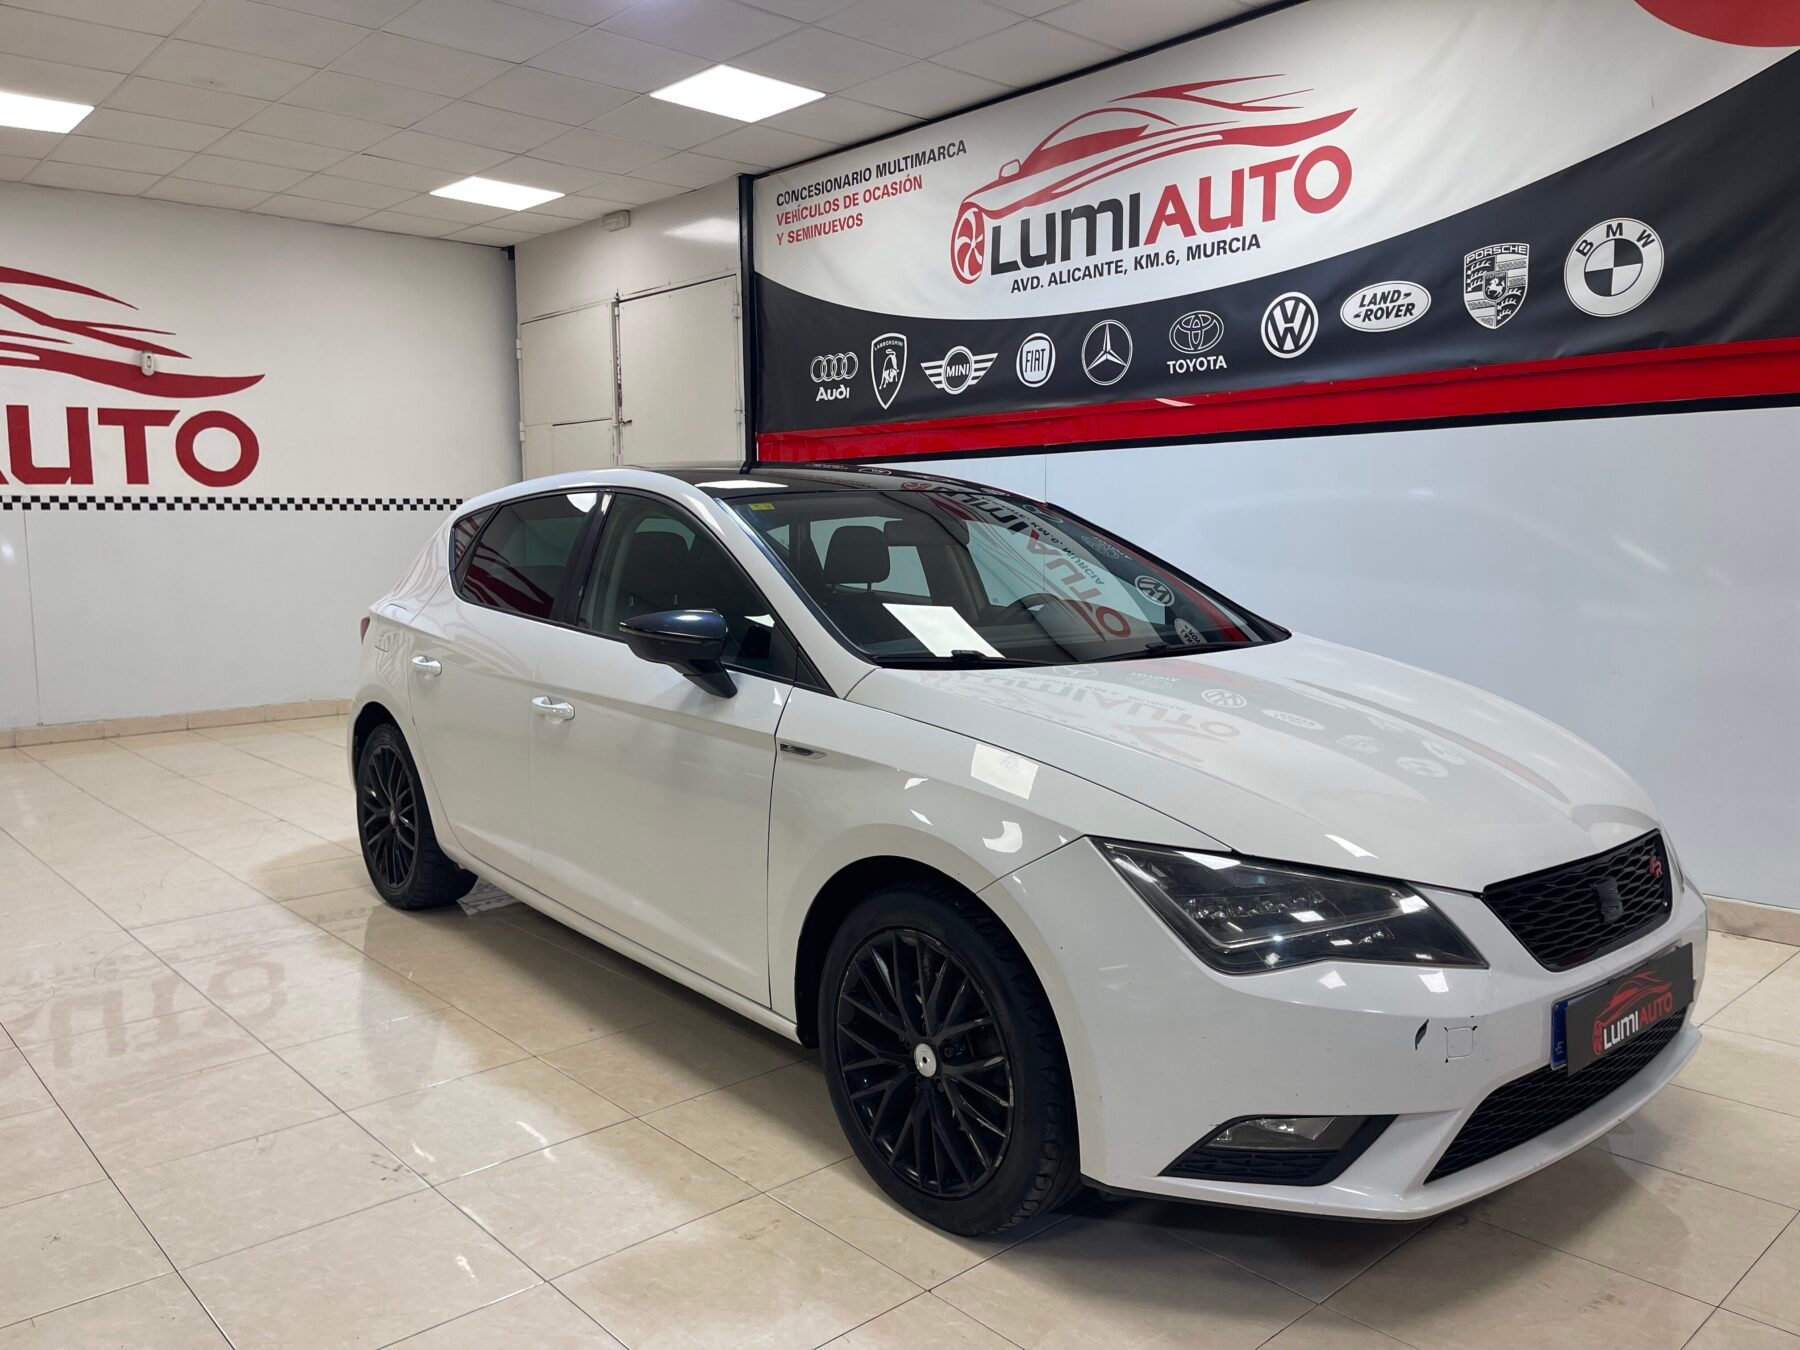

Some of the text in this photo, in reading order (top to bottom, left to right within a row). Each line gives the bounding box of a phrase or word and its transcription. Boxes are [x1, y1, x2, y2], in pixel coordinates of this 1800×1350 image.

[776, 139, 967, 207] CONCESIONARIO MULTIMARCA
[776, 174, 923, 226] VEHÍCULOS DE OCASIÓN
[776, 212, 864, 246] Y SEMINUEVOS
[1576, 222, 1656, 257] BMW
[1010, 233, 1262, 294] AVD. ALICANTE, KM.6, MURCIA
[1466, 245, 1527, 264] PORSCHE
[946, 362, 970, 378] MINI
[1025, 348, 1047, 373] FIAT
[1167, 355, 1228, 375] TOYOTA
[815, 384, 850, 402] Audi
[0, 404, 260, 487] UTO
[1603, 991, 1673, 1050] LUMIAUTO
